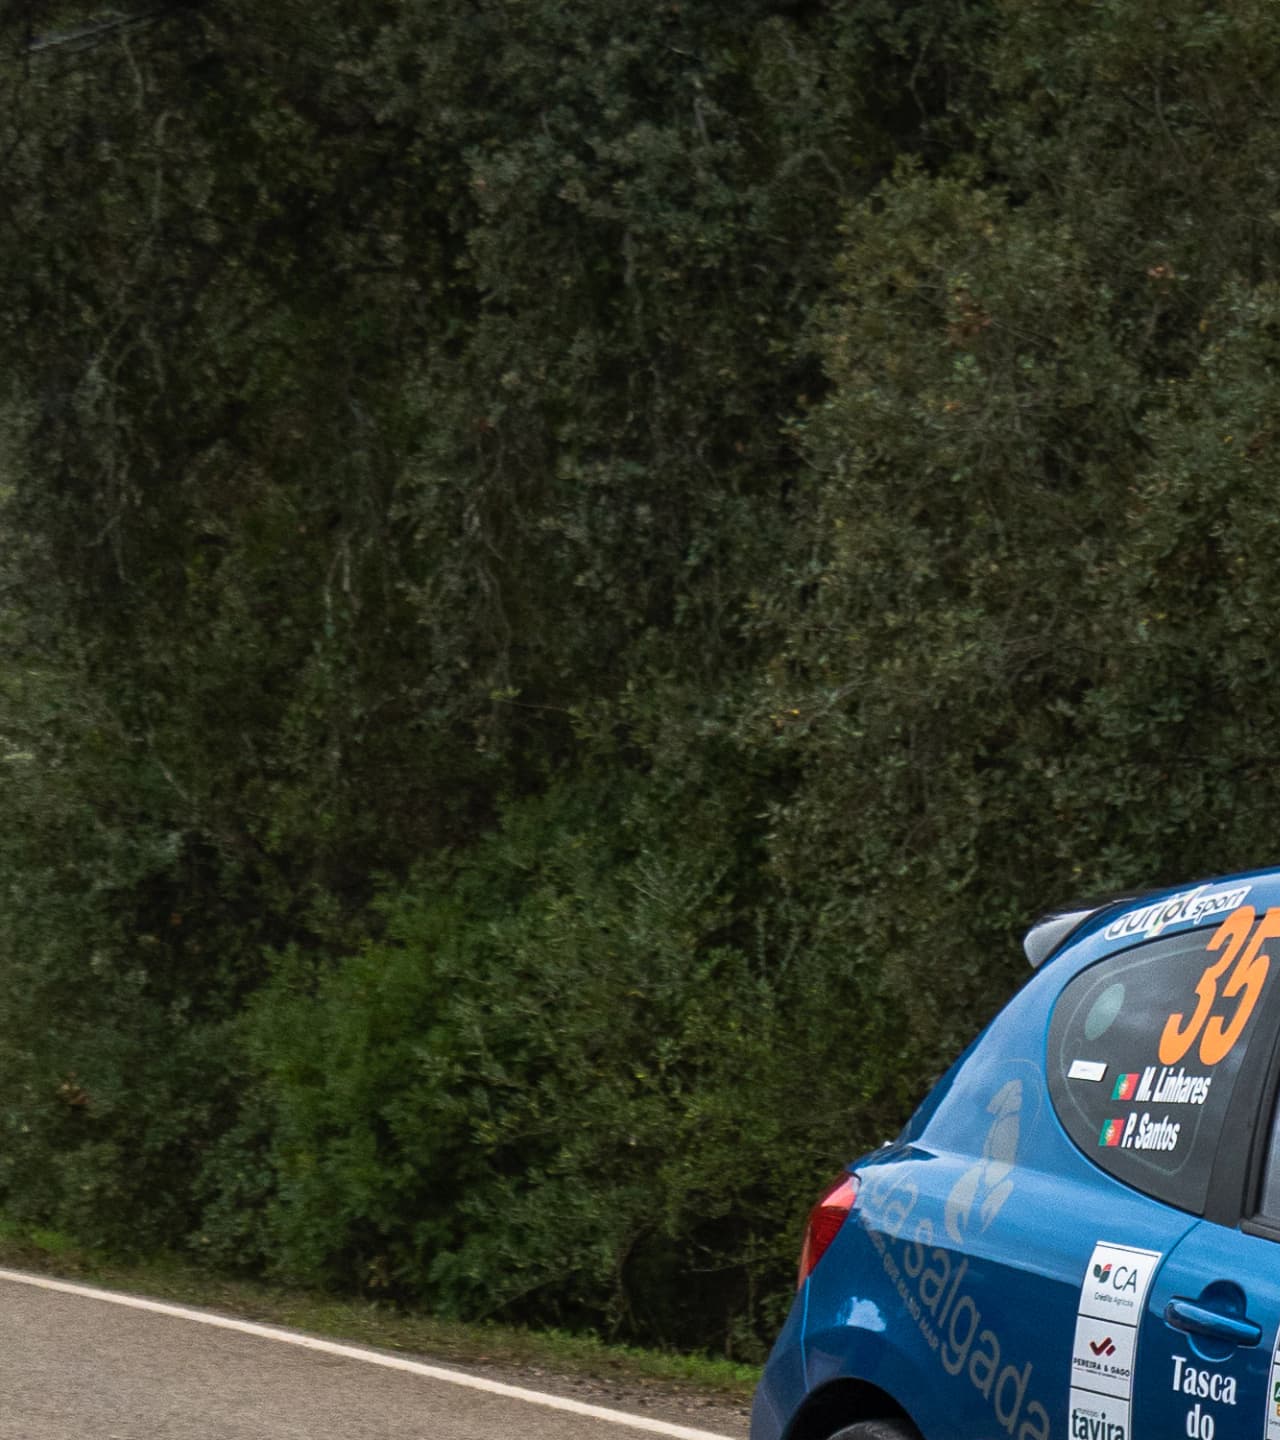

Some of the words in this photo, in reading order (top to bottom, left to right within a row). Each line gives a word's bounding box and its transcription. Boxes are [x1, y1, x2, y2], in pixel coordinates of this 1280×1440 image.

[1192, 890, 1246, 921] sport
[1152, 1066, 1212, 1105] Linhares
[1121, 1112, 1138, 1148] P.
[1134, 1114, 1181, 1151] Santos
[1112, 1265, 1138, 1293] CA
[1171, 1354, 1237, 1405] Tasca
